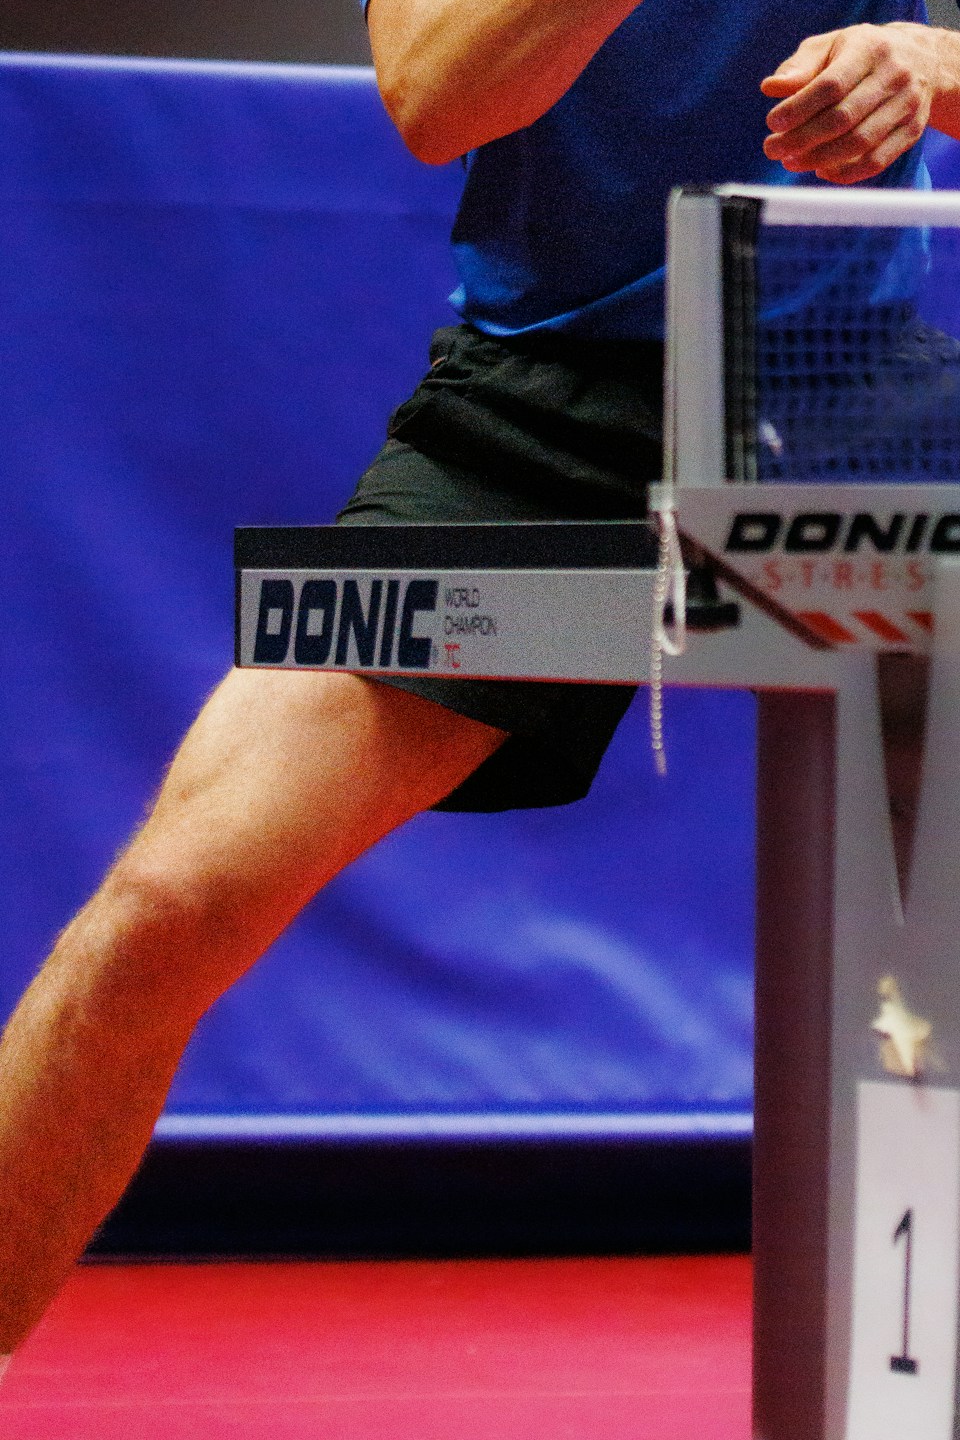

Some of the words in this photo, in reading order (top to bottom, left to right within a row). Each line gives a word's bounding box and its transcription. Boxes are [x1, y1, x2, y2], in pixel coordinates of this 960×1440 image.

[254, 580, 439, 668] DONIC
[445, 588, 480, 608] WORLD
[444, 643, 461, 669] TC
[890, 1208, 919, 1375] 1
